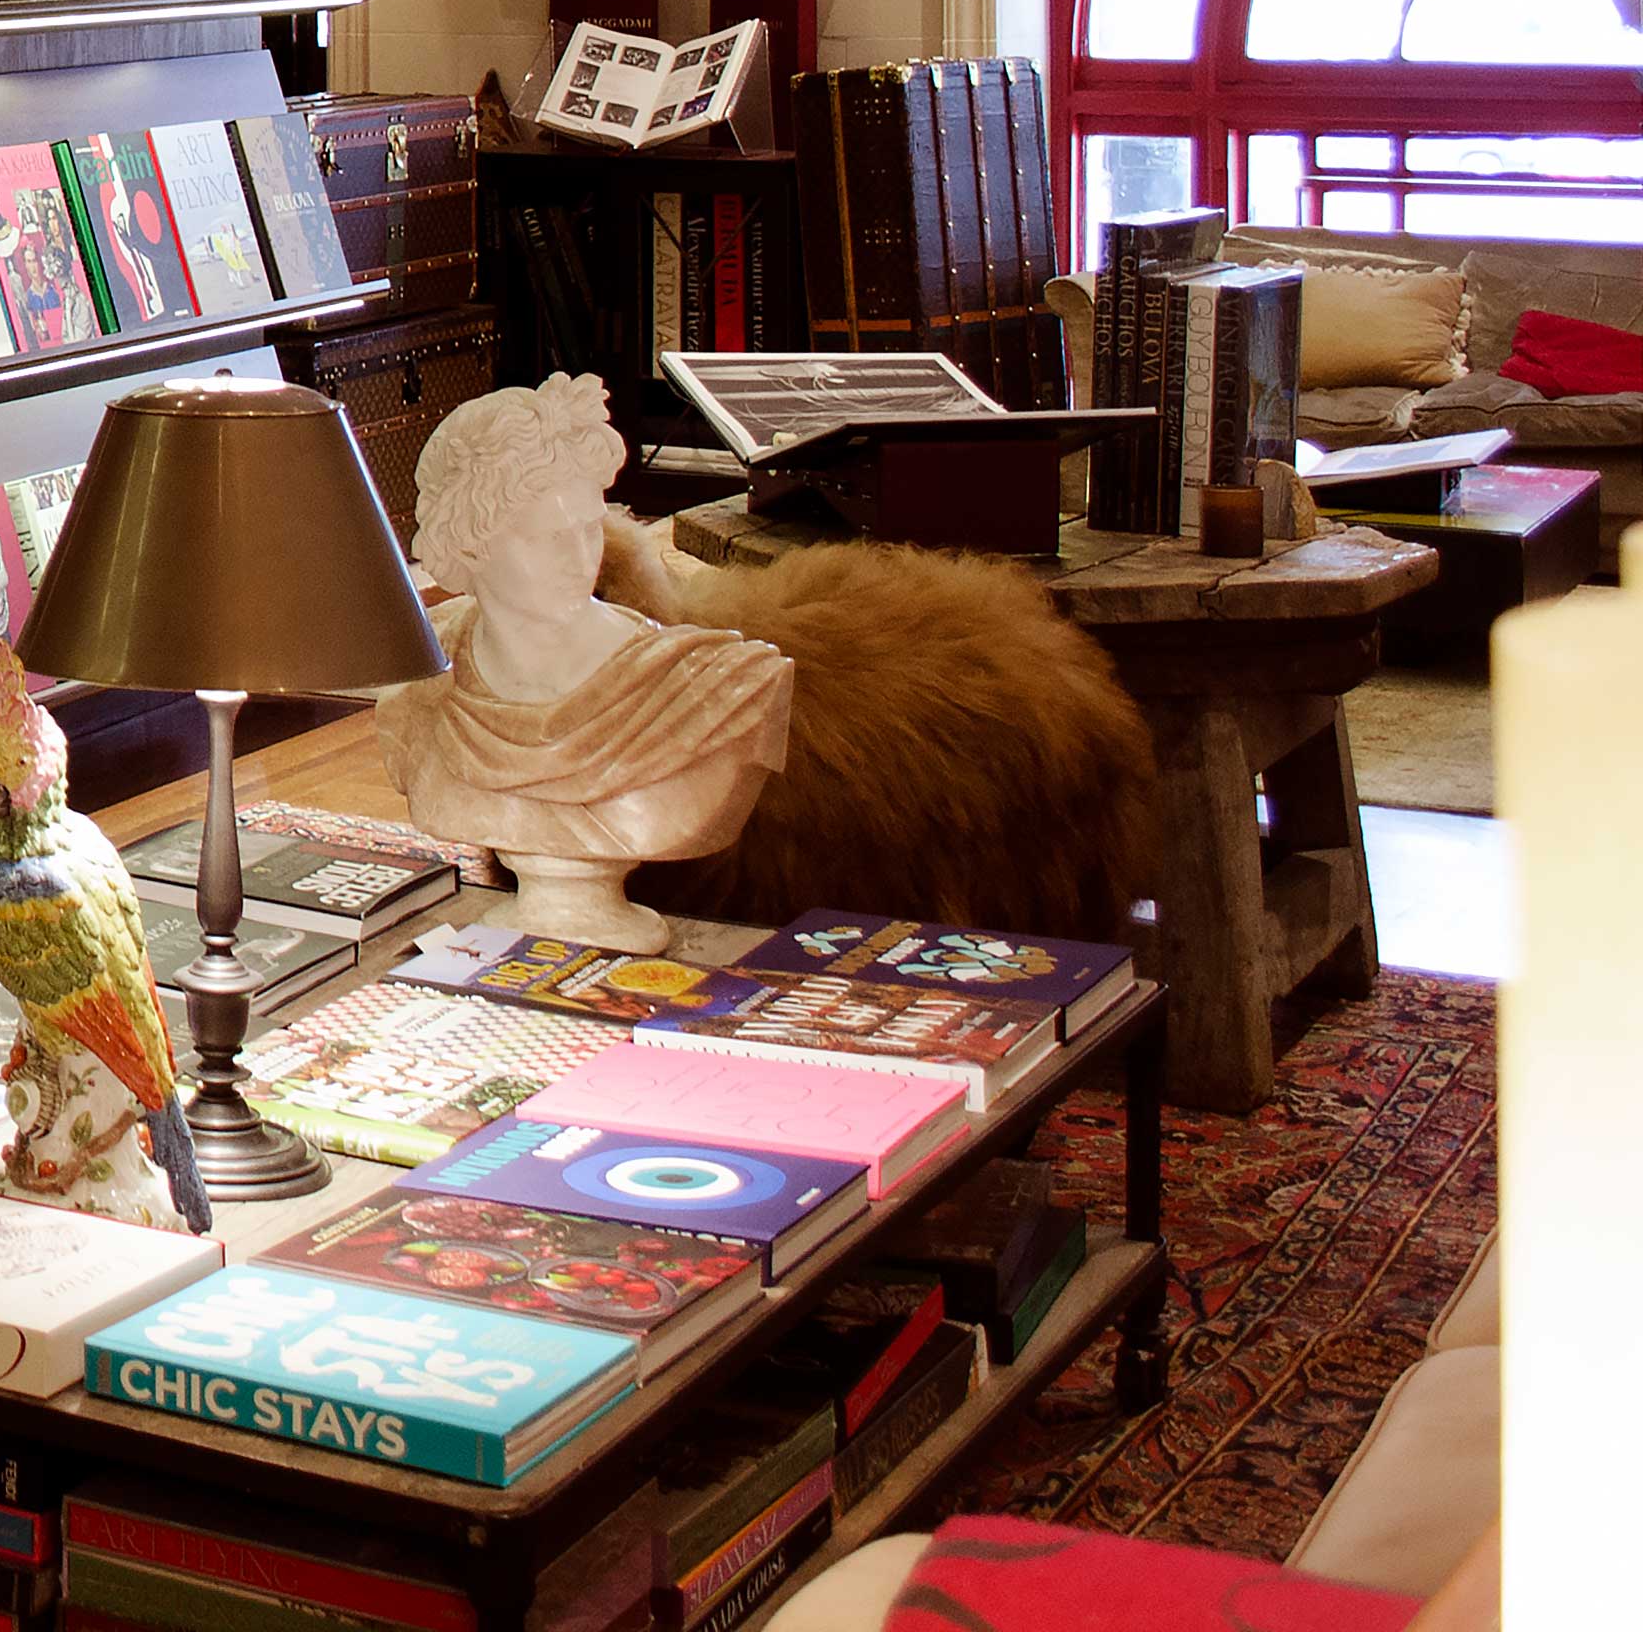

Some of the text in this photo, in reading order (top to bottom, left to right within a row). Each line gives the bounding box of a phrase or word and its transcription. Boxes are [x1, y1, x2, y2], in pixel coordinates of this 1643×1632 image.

[11, 149, 52, 173] KAHLO
[79, 148, 156, 186] cardin
[175, 132, 214, 167] ART
[173, 171, 241, 212] FLYING
[274, 192, 315, 214] BULOVA
[523, 208, 547, 251] GOLF
[1118, 255, 1136, 357] GAUCHOS
[1142, 292, 1163, 384] BULOVA
[1183, 294, 1212, 468] GUY BOURDIN
[426, 1120, 564, 1187] MYKONOS
[532, 1125, 603, 1161] MUSE
[144, 1277, 339, 1360] CHIC
[119, 1358, 409, 1459] CHIC STAYS
[94, 1515, 302, 1594] ART FLYING
